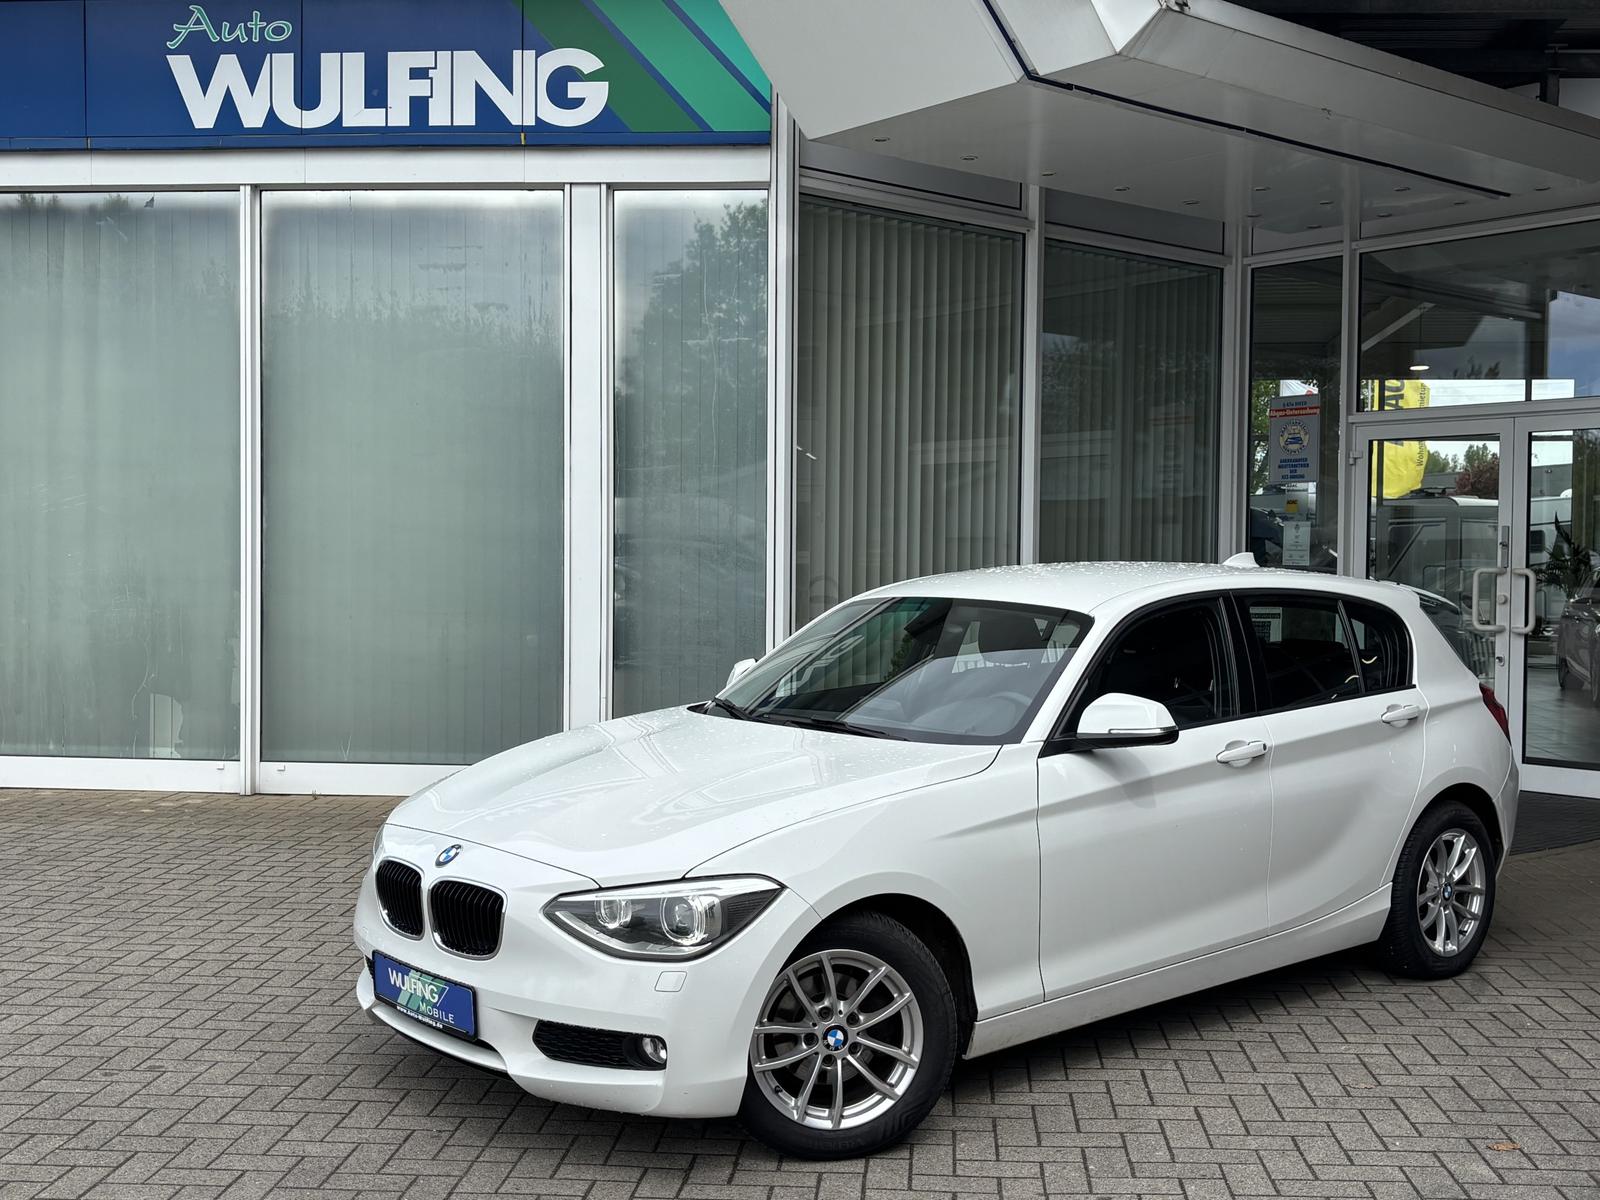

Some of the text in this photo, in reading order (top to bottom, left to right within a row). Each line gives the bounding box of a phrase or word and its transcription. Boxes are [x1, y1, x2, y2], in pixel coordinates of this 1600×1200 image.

[166, 5, 292, 49] Auto
[166, 47, 609, 130] WULFING
[388, 967, 439, 1003] WULFING
[419, 1001, 455, 1024] MOBILE
